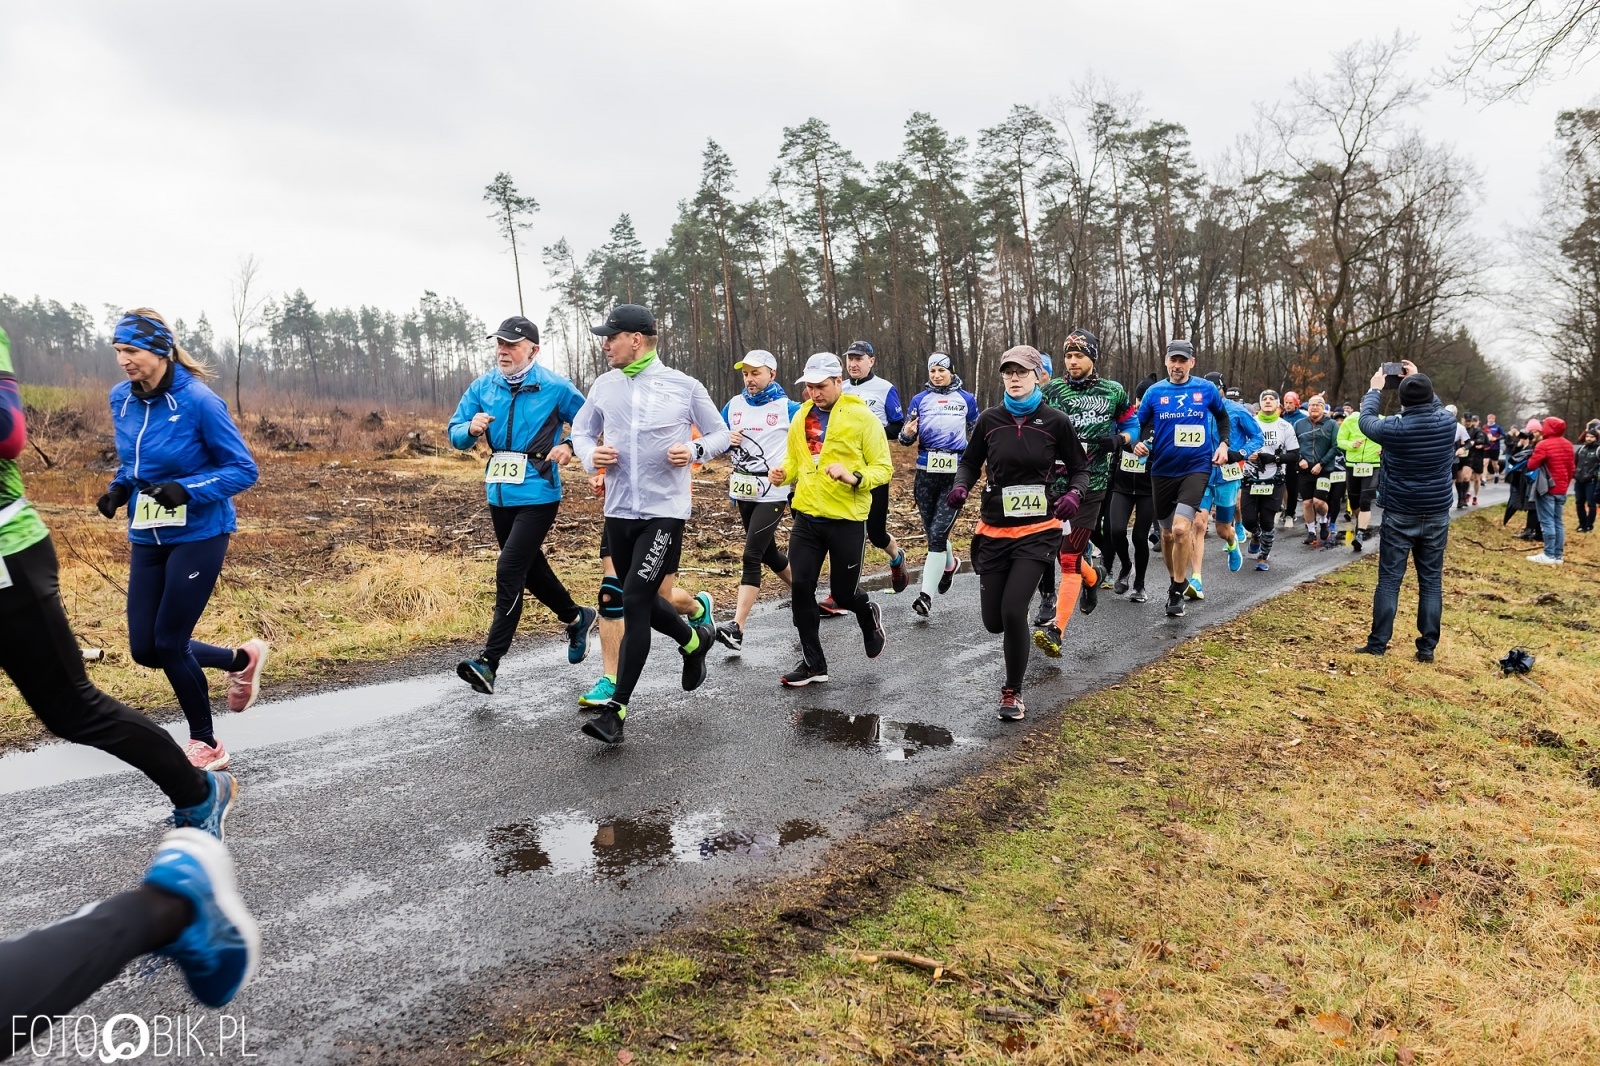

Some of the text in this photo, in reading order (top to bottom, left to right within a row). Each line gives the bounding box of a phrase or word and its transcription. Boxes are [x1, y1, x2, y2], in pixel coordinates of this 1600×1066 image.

[1082, 410, 1096, 418] PO
[1160, 411, 1185, 419] HRmax
[1180, 432, 1201, 443] 212
[932, 458, 953, 469] 204
[493, 463, 518, 477] 213
[733, 481, 752, 495] 249
[1010, 495, 1041, 511] 244
[637, 528, 669, 580] NIKE
